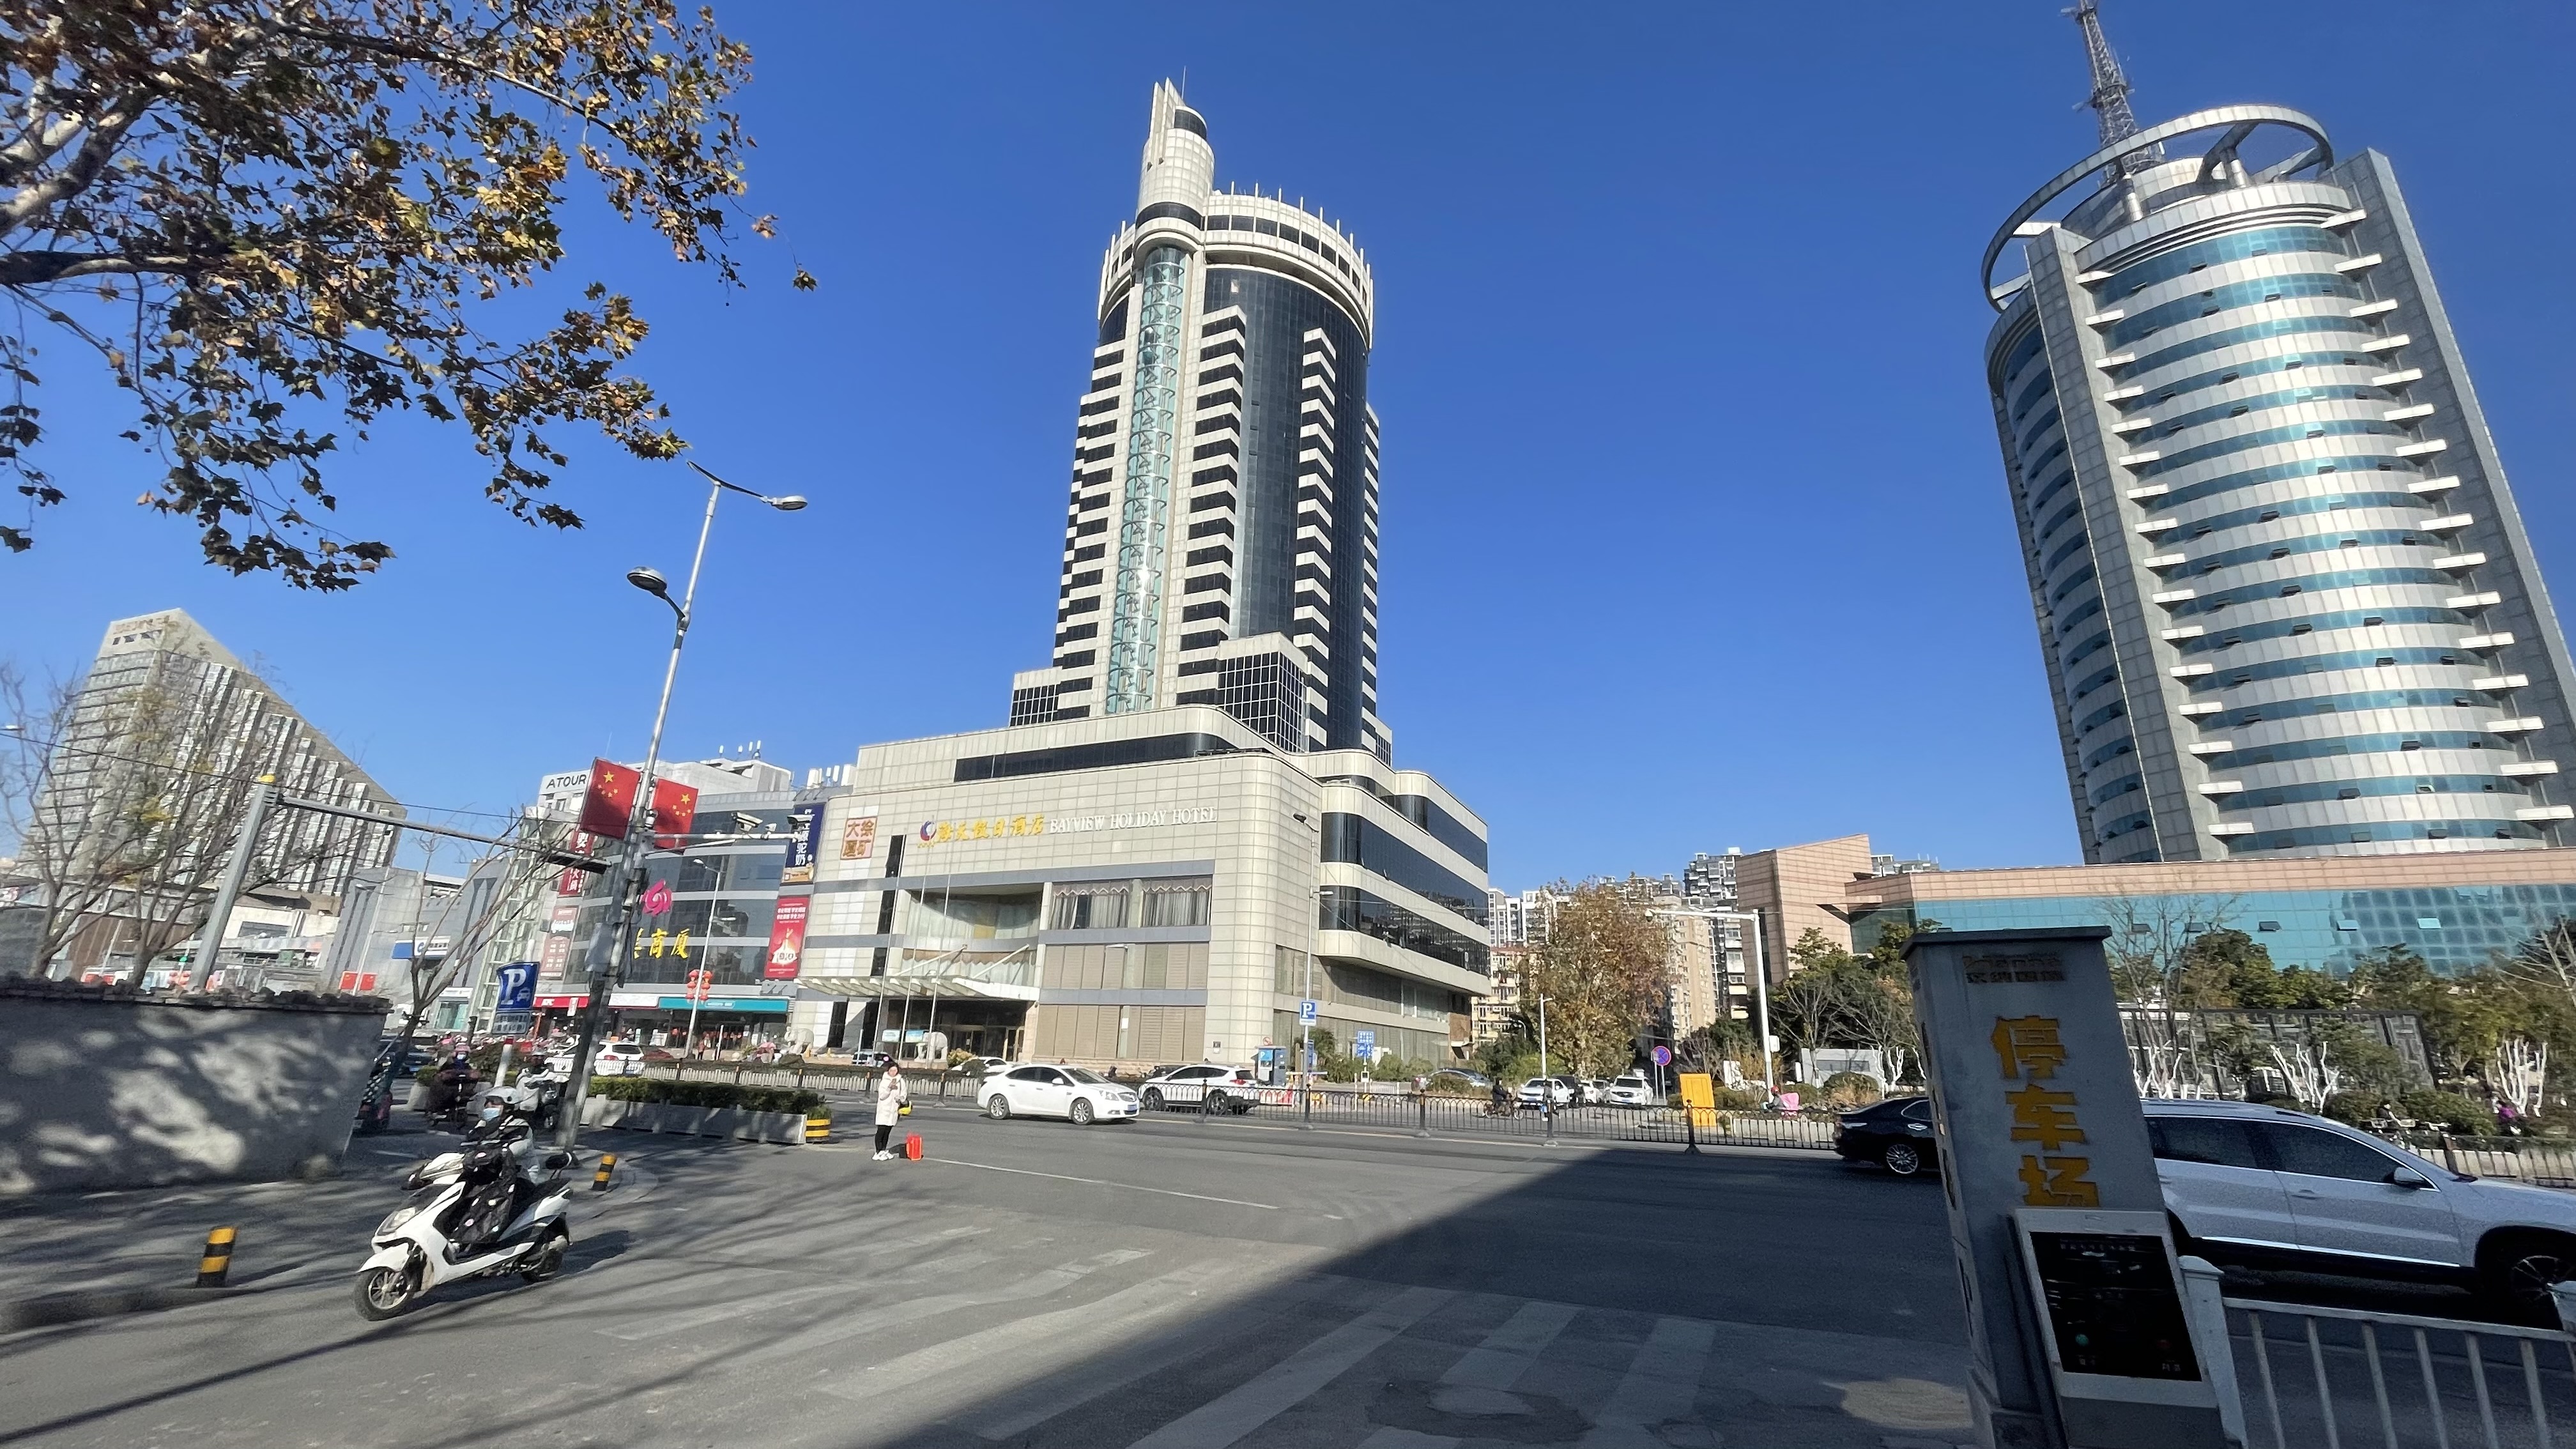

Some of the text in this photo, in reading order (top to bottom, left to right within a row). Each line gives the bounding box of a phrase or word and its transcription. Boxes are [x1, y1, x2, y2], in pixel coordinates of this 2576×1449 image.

[546, 774, 586, 789] ATOUR
[1050, 806, 1218, 834] BAYVIEW HOLIDAY HOTEL
[501, 969, 526, 1005] P
[1301, 1002, 1313, 1018] P
[1990, 1015, 2100, 1206] 停车场
